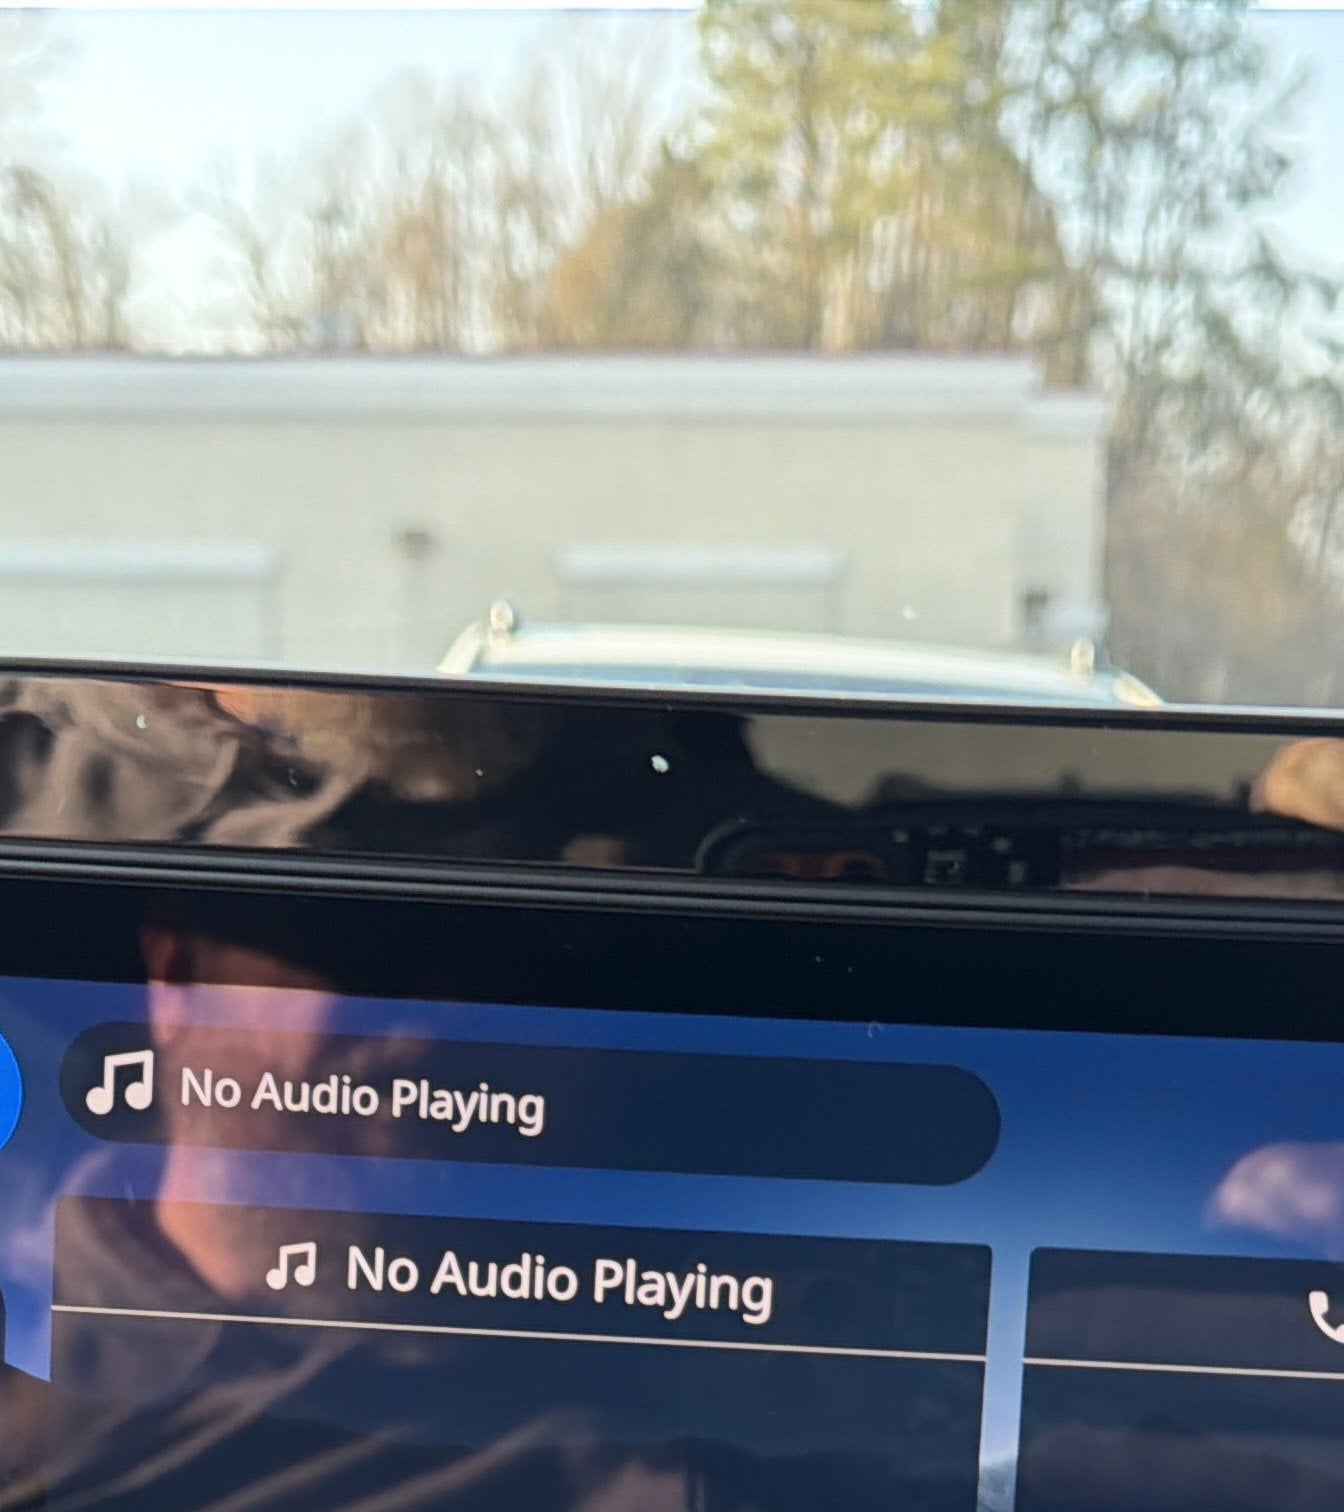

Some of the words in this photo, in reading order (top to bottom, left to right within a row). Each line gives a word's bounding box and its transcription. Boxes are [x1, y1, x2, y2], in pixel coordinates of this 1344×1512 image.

[181, 1067, 242, 1108] No
[250, 1071, 380, 1116] Audio
[391, 1078, 545, 1137] Playing
[347, 1245, 419, 1293] No
[429, 1250, 579, 1301] Audio
[593, 1258, 773, 1325] Playing
